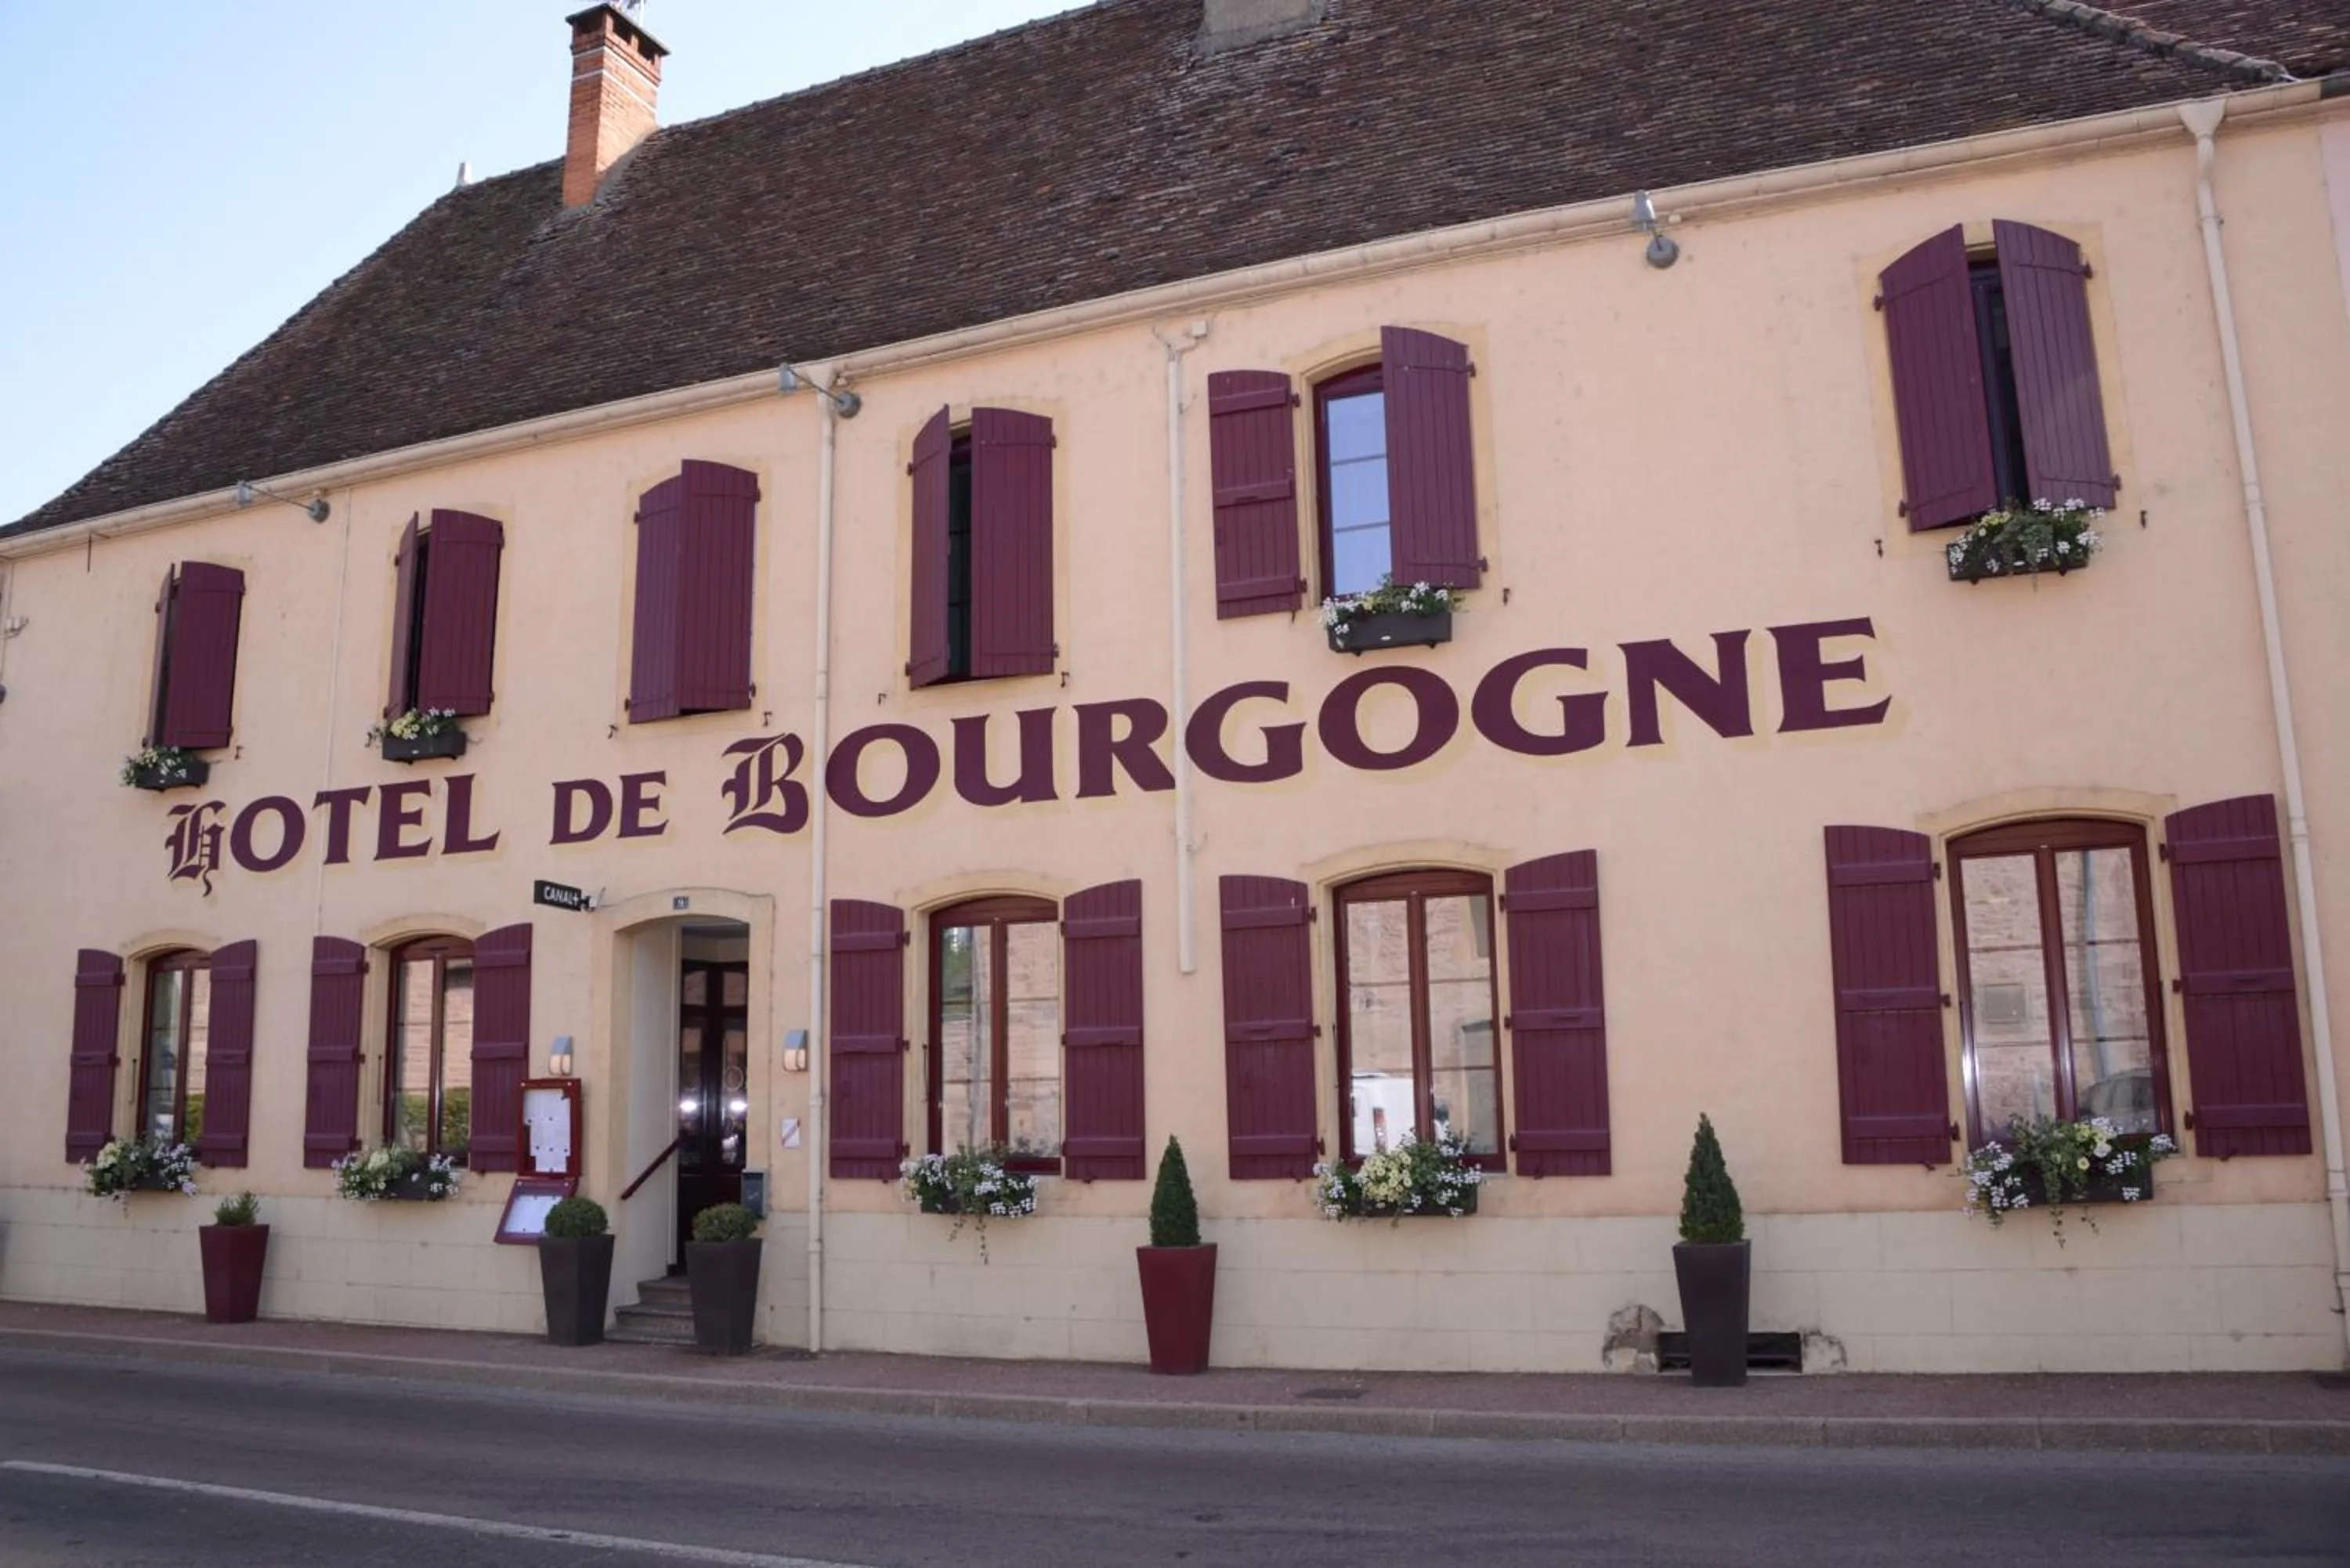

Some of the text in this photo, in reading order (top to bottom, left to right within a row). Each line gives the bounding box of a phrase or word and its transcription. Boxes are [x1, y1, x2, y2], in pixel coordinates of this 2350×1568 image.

[164, 617, 1892, 897] HOTEL DE BOURGOGNE
[544, 886, 579, 906] CANAL+
